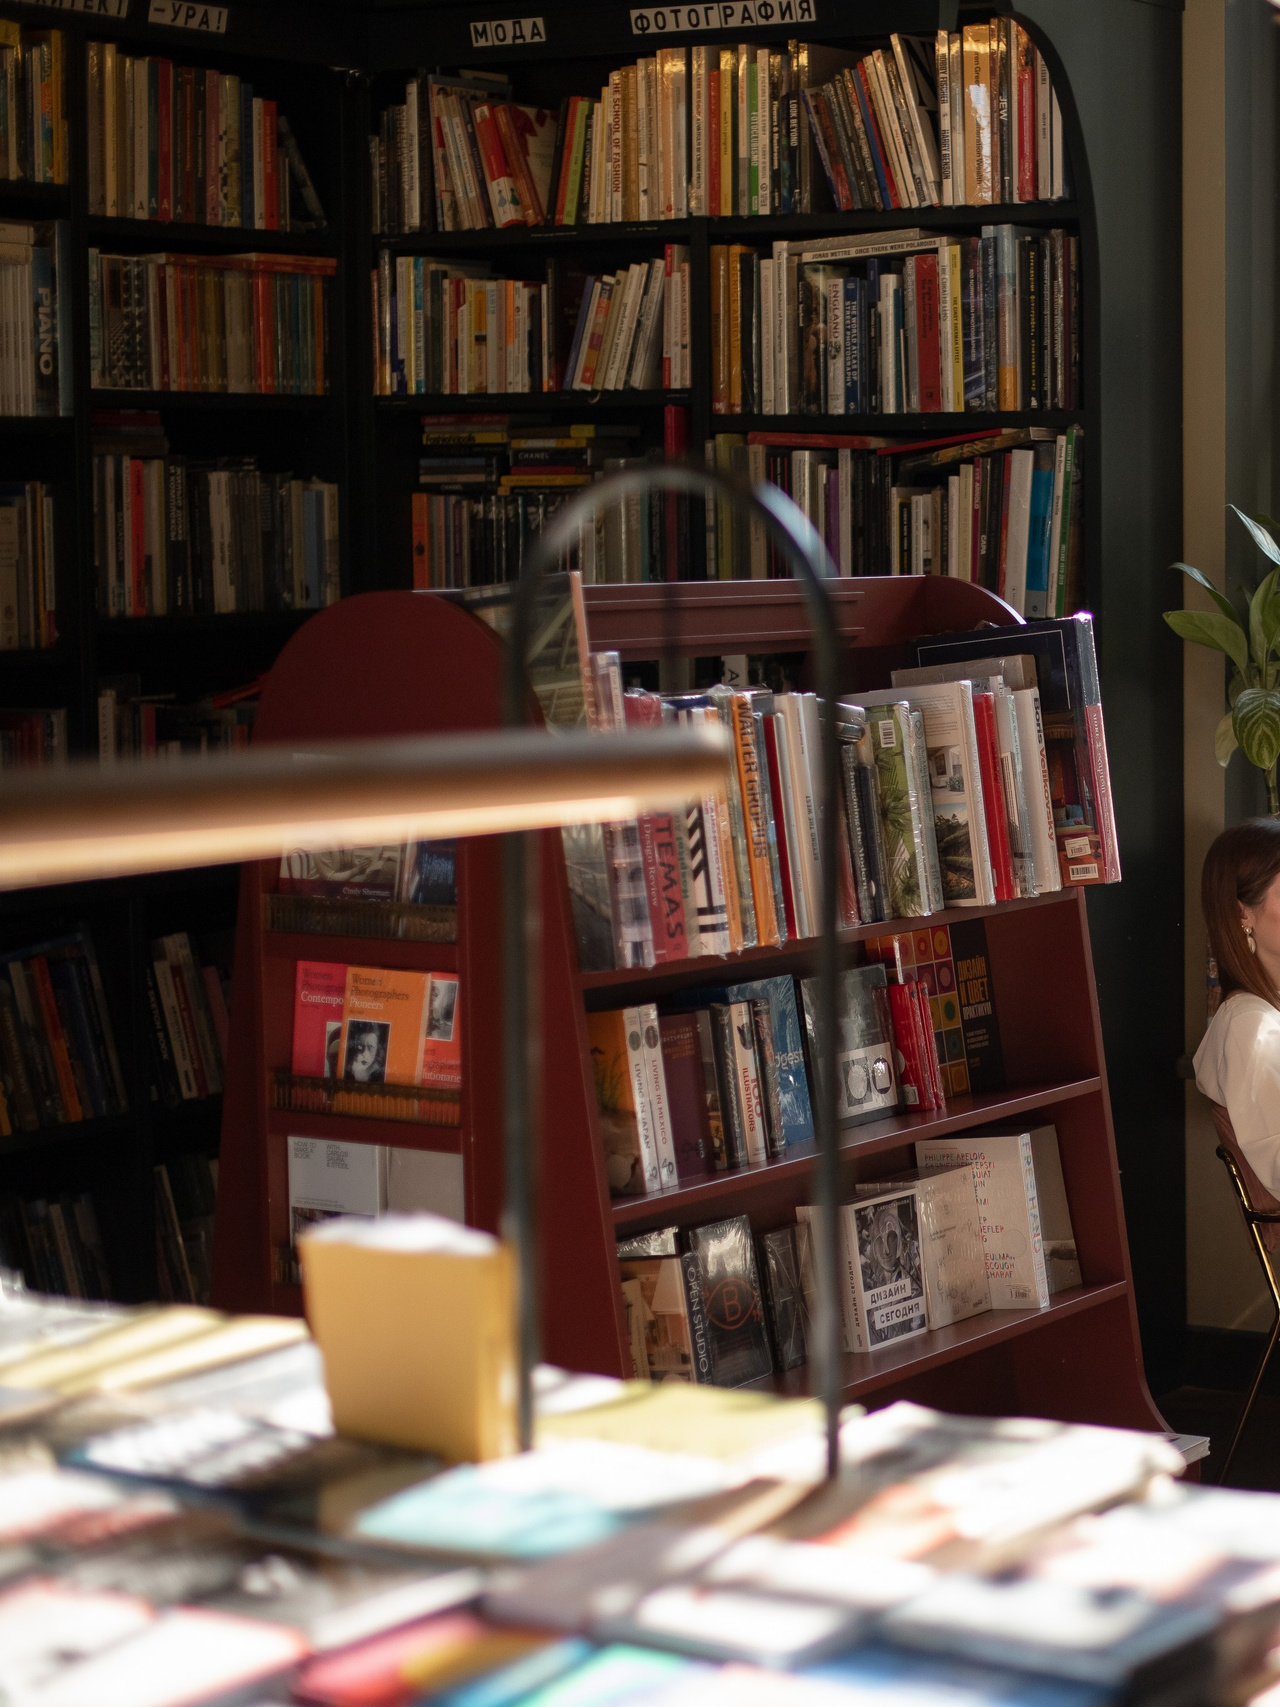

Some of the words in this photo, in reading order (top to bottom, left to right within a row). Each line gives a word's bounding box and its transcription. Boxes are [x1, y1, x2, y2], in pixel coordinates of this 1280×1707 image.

[633, 0, 813, 34] ФОТОГРАФИЯ
[472, 20, 543, 44] МОДА
[940, 77, 949, 105] FISCHER
[612, 97, 622, 136] SCHOOL
[789, 100, 799, 118] LOOK
[999, 95, 1008, 121] JEW
[612, 138, 622, 151] OF
[789, 118, 799, 147] BEYOND
[941, 130, 950, 152] HARRY
[612, 153, 622, 194] FASHION
[942, 153, 951, 180] BENSON
[975, 158, 983, 185] Wealth
[904, 240, 937, 249] POLAROIDS
[906, 260, 914, 274] Our
[906, 275, 915, 301] Selves
[968, 279, 976, 312] NORWEGIAN
[832, 283, 840, 339] ENGLAND
[844, 301, 852, 330] STREET
[850, 301, 858, 315] THE
[38, 286, 53, 376] PIANO
[850, 316, 859, 344] WORLD
[952, 322, 960, 345] SHERMAN
[969, 312, 977, 362] PHOTOGRAPHERS
[851, 345, 859, 366] ATLAS
[851, 367, 859, 380] OF
[517, 452, 550, 460] CHANEL
[973, 467, 981, 481] EVE
[973, 481, 981, 510] ARNOLD
[979, 534, 988, 555] CAPA
[1059, 544, 1067, 562] IRELAND
[737, 701, 759, 776] WALTER
[1033, 697, 1045, 744] Boris
[1039, 746, 1055, 842] Velikovsky
[804, 795, 814, 817] WEST
[746, 779, 768, 861] GROPIUS
[807, 817, 816, 831] THE
[848, 770, 862, 825] Imagining
[857, 839, 870, 890] Modern
[641, 823, 656, 863] Design
[809, 831, 820, 862] BEYOND
[342, 887, 361, 896] Cindy
[361, 888, 392, 897] Sherman
[647, 866, 660, 907] Review
[655, 819, 685, 940] TEMAS
[351, 973, 383, 987] Women
[956, 953, 987, 982] ДИЗАЙН
[300, 990, 344, 1008] Contempo
[349, 996, 384, 1011] Pioneers
[350, 985, 410, 1002] Photographers
[967, 978, 989, 1005] ЦВЕТ
[633, 1063, 645, 1098] LIVING
[651, 1059, 662, 1092] LIVING
[638, 1099, 646, 1114] IN
[655, 1093, 663, 1106] IN
[742, 1066, 757, 1133] ILLUSTRATORS
[752, 1077, 763, 1119] 100
[639, 1116, 651, 1150] JAPAN
[656, 1106, 668, 1146] MEXICO
[924, 1152, 955, 1162] PHILIPPE
[956, 1151, 987, 1162] APELOIG
[686, 1265, 701, 1313] OPEN
[847, 1260, 856, 1295] СЕГОДНЯ
[869, 1282, 908, 1306] ДИЗАЙН
[852, 1295, 861, 1329] ДИЗАЙН
[878, 1300, 921, 1326] СЕГОДНЯ
[691, 1314, 710, 1374] STUDIO
